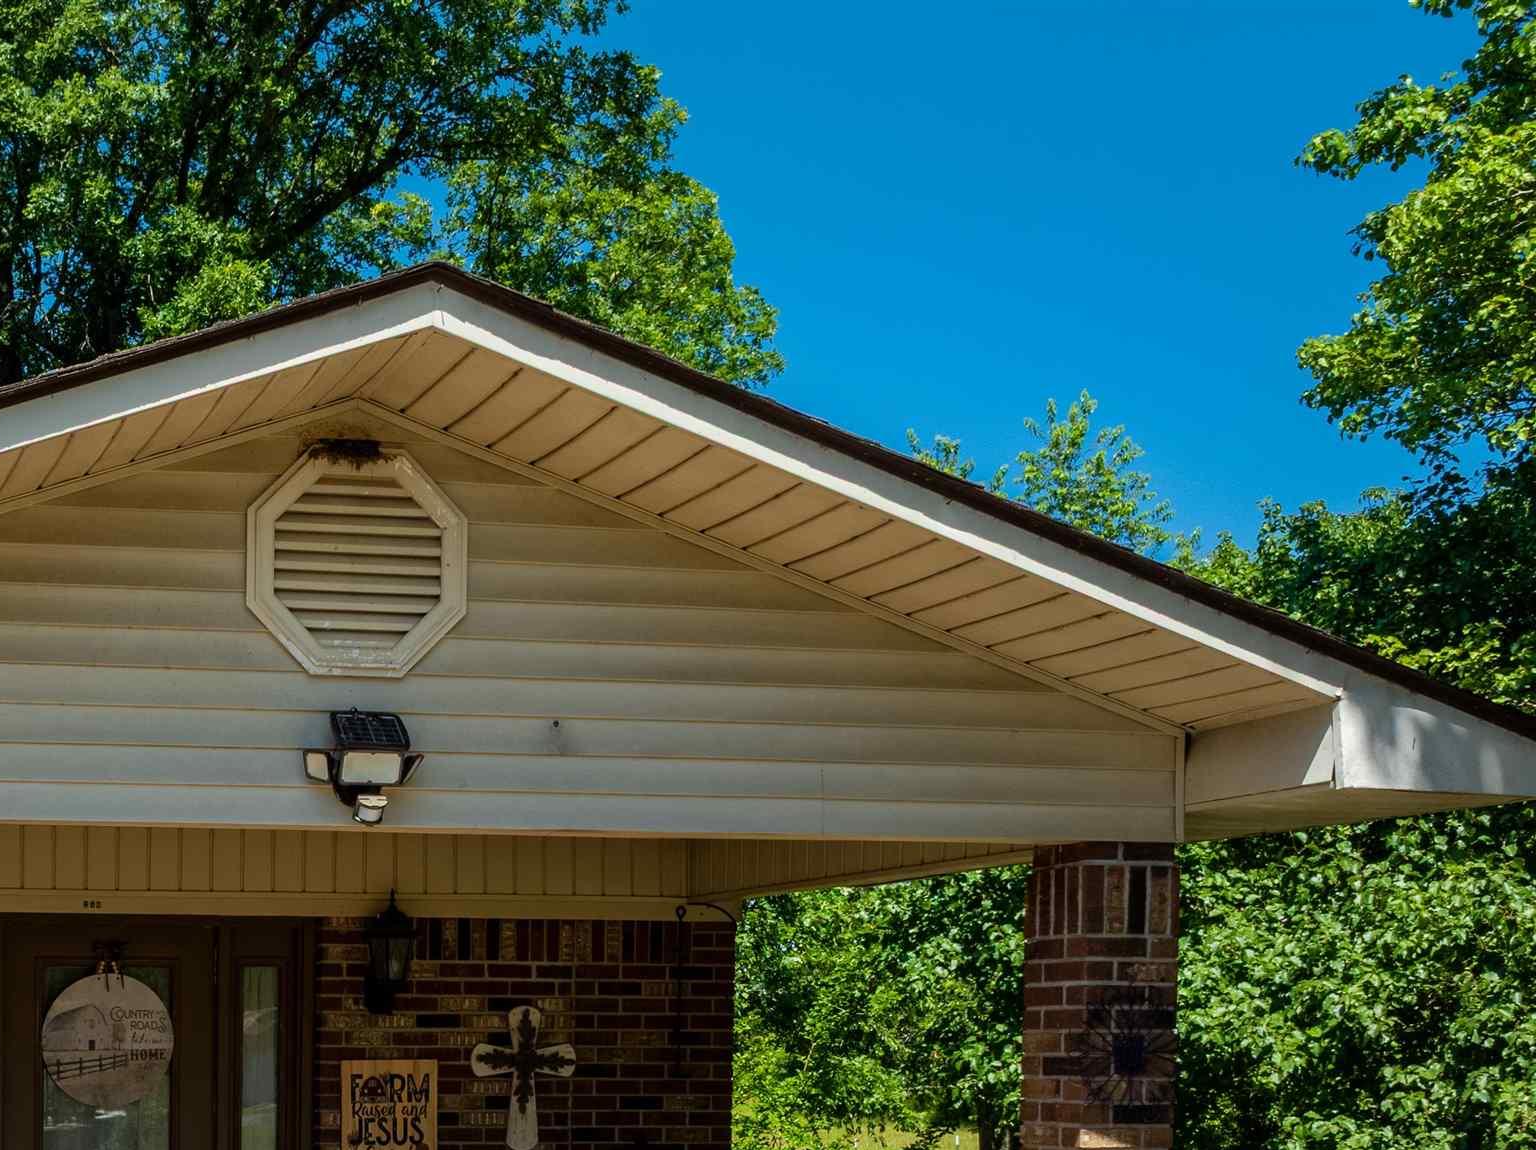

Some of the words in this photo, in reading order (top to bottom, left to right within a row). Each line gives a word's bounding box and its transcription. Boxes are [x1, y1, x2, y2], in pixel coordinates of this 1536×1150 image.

[111, 1006, 154, 1022] COUNTRY
[130, 1014, 167, 1033] ROADS
[130, 1048, 167, 1061] HOME
[352, 1101, 396, 1120] Raised
[401, 1103, 428, 1119] and
[350, 1117, 424, 1146] JESUS
